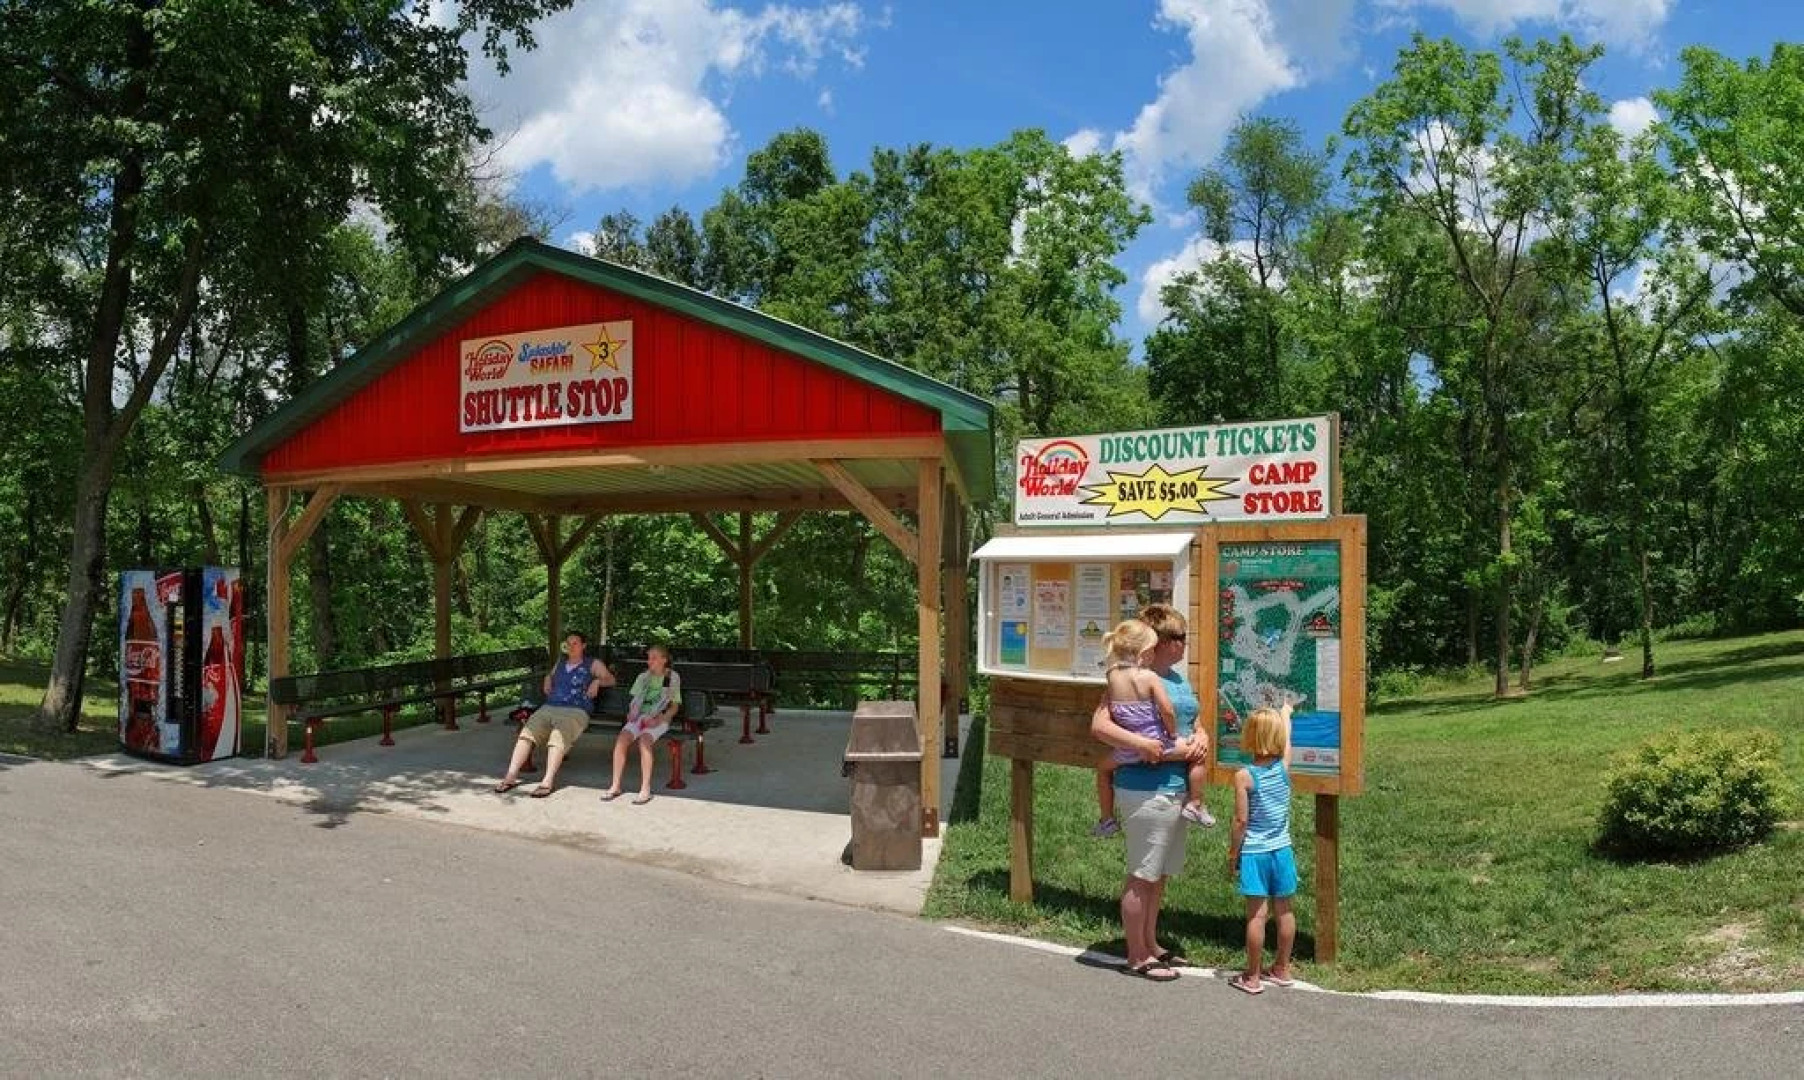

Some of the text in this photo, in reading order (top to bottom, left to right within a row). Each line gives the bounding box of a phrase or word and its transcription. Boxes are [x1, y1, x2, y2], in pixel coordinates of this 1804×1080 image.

[599, 341, 609, 360] 3
[464, 377, 629, 426] SHUTTLE STOP
[1099, 423, 1317, 464] DISCOUNT TICKETS
[1021, 455, 1089, 479] Holiday
[1249, 461, 1317, 485] CAMP
[1020, 477, 1076, 496] World
[1118, 480, 1198, 502] SAVE $5.00
[1243, 490, 1322, 514] STORE
[1222, 547, 1258, 558] CAMP
[1260, 545, 1305, 556] STORE
